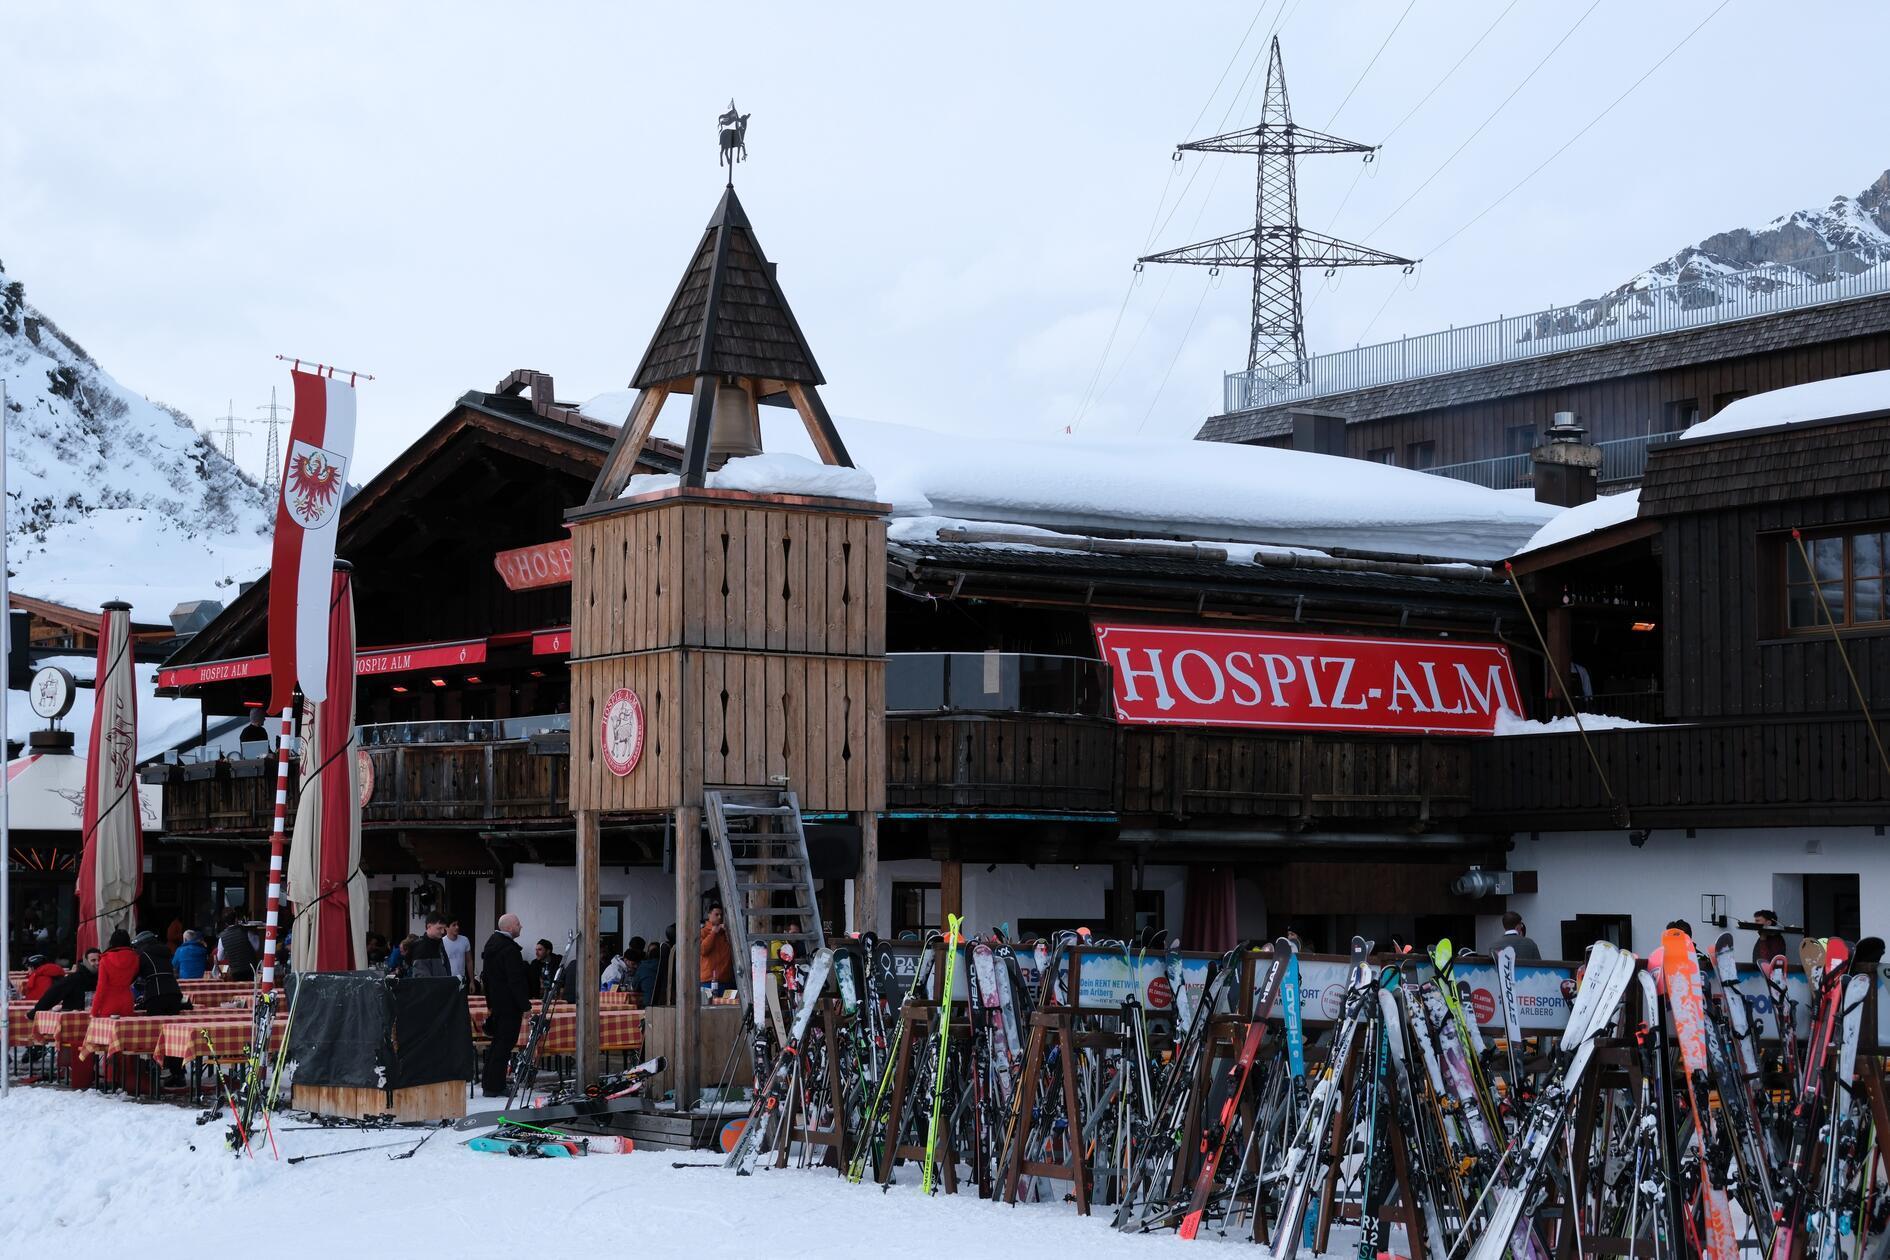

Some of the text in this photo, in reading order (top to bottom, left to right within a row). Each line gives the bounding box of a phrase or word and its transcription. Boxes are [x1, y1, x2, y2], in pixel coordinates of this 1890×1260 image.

[515, 547, 571, 584] HOSP
[391, 654, 411, 670] ALM
[200, 663, 248, 681] HOSPIZ ALM
[1111, 646, 1503, 716] HOSPIZ-ALM
[969, 963, 979, 1010] HEAD
[1095, 979, 1112, 989] RENT
[1260, 960, 1280, 1004] HEAD
[1517, 995, 1566, 1009] TERSPORT
[1285, 983, 1300, 1044] HEAD
[1520, 1007, 1554, 1017] ARLBERG
[1362, 1214, 1380, 1231] RX
[1361, 1230, 1379, 1246] 12
